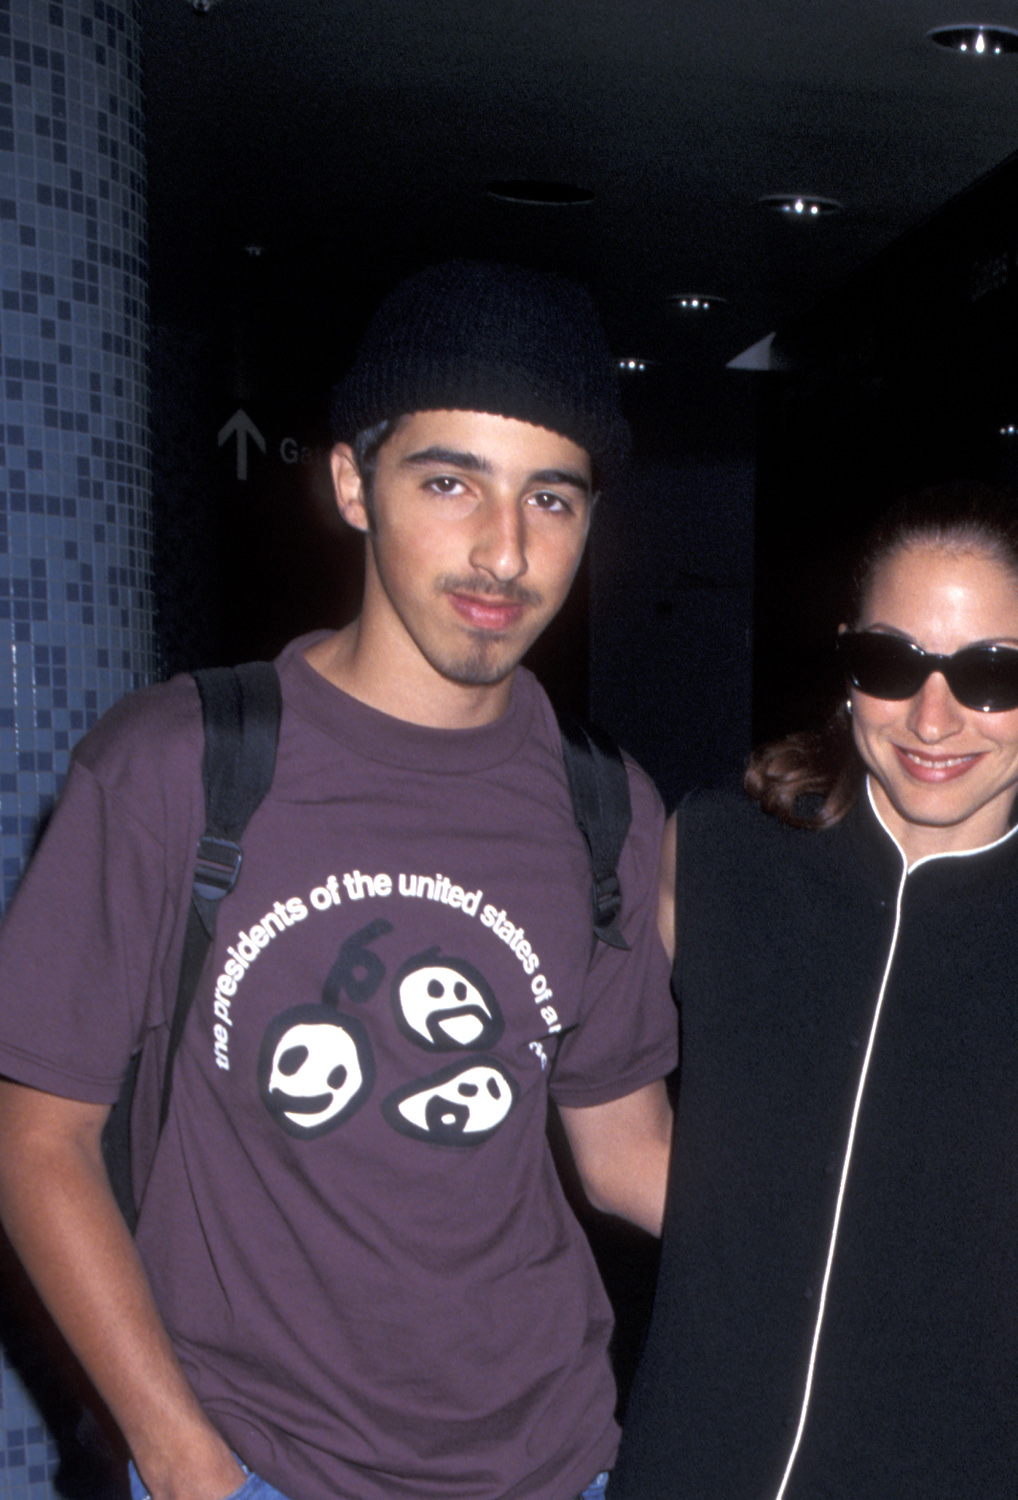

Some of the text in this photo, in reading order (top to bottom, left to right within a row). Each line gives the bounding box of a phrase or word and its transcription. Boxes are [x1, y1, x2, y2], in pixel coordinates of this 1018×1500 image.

[213, 869, 553, 1071] the presidents of the united states of
